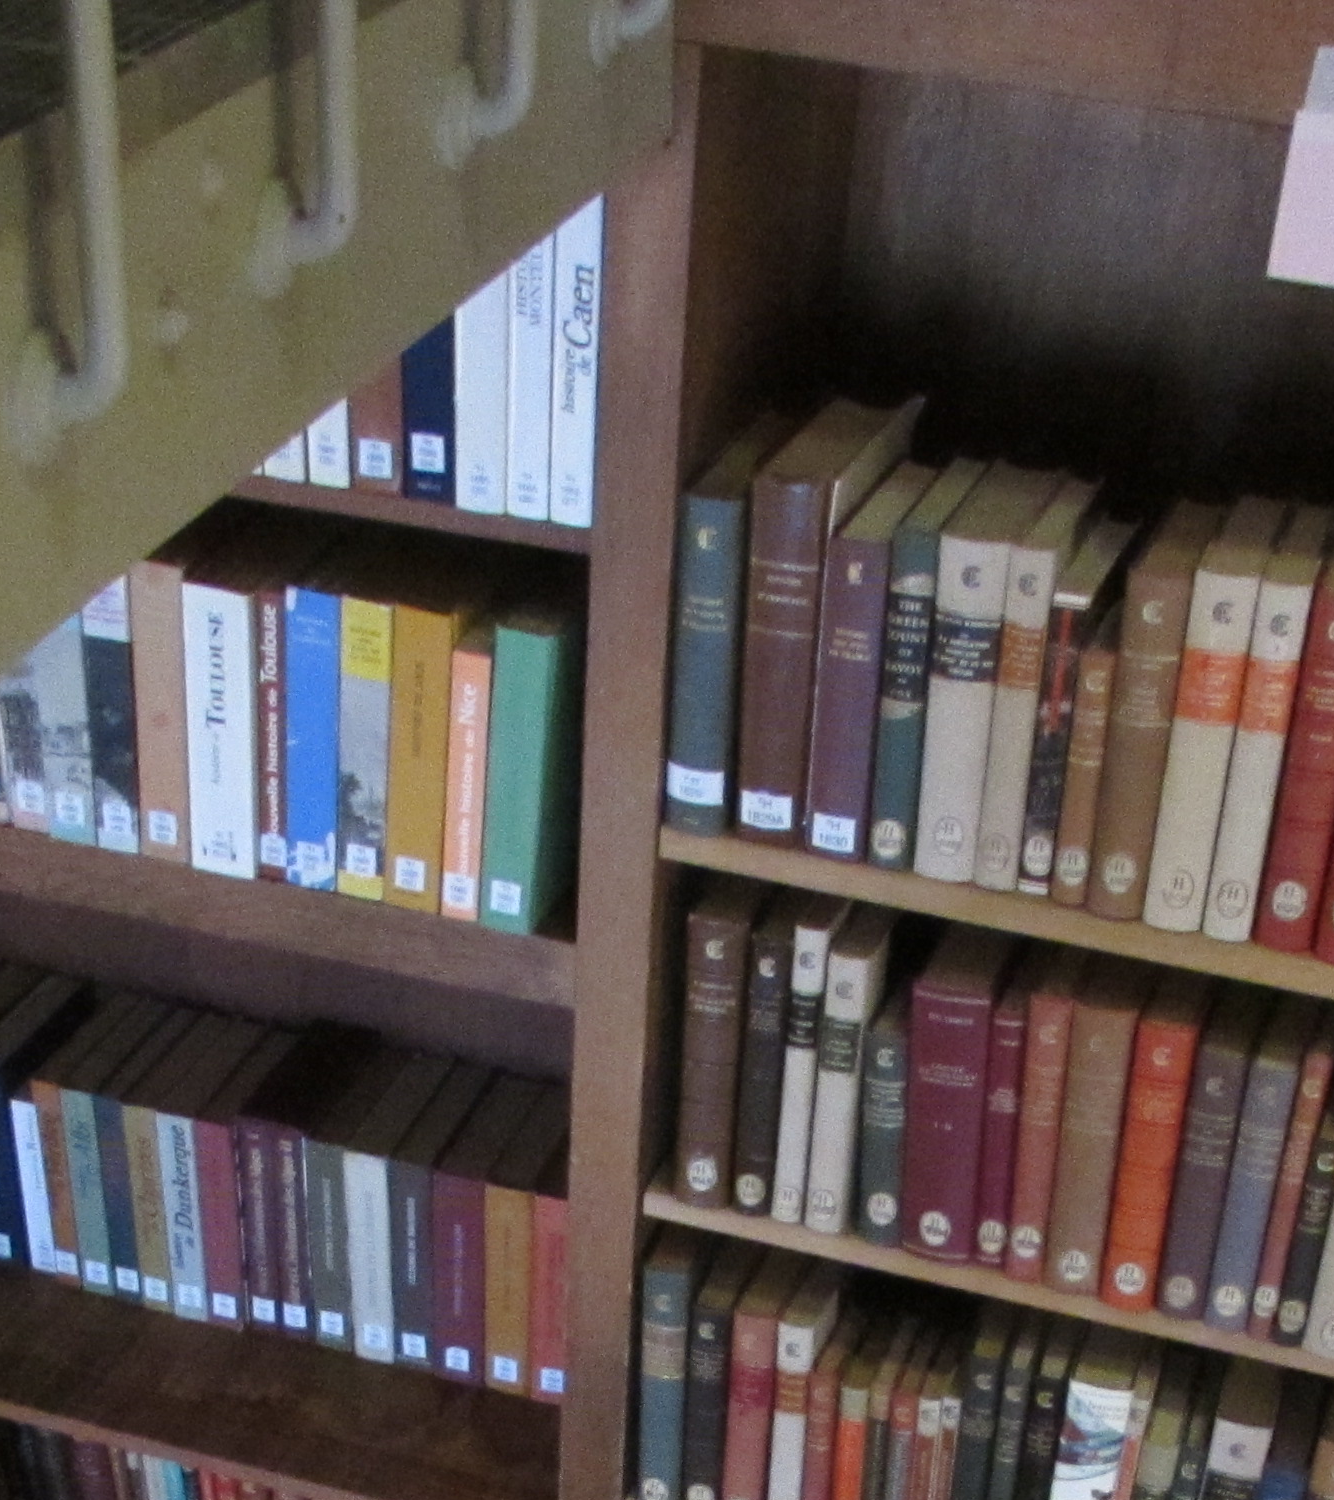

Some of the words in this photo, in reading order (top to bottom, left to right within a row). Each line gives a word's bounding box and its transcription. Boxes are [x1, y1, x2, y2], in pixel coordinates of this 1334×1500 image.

[562, 264, 595, 348] Caen
[260, 605, 277, 682] Toulouse
[267, 687, 277, 707] de
[459, 684, 476, 725] Nice
[266, 712, 278, 772] histoire
[268, 777, 278, 833] ouvelle
[457, 819, 470, 873] ouvelle
[171, 1127, 193, 1231] Dunkerque
